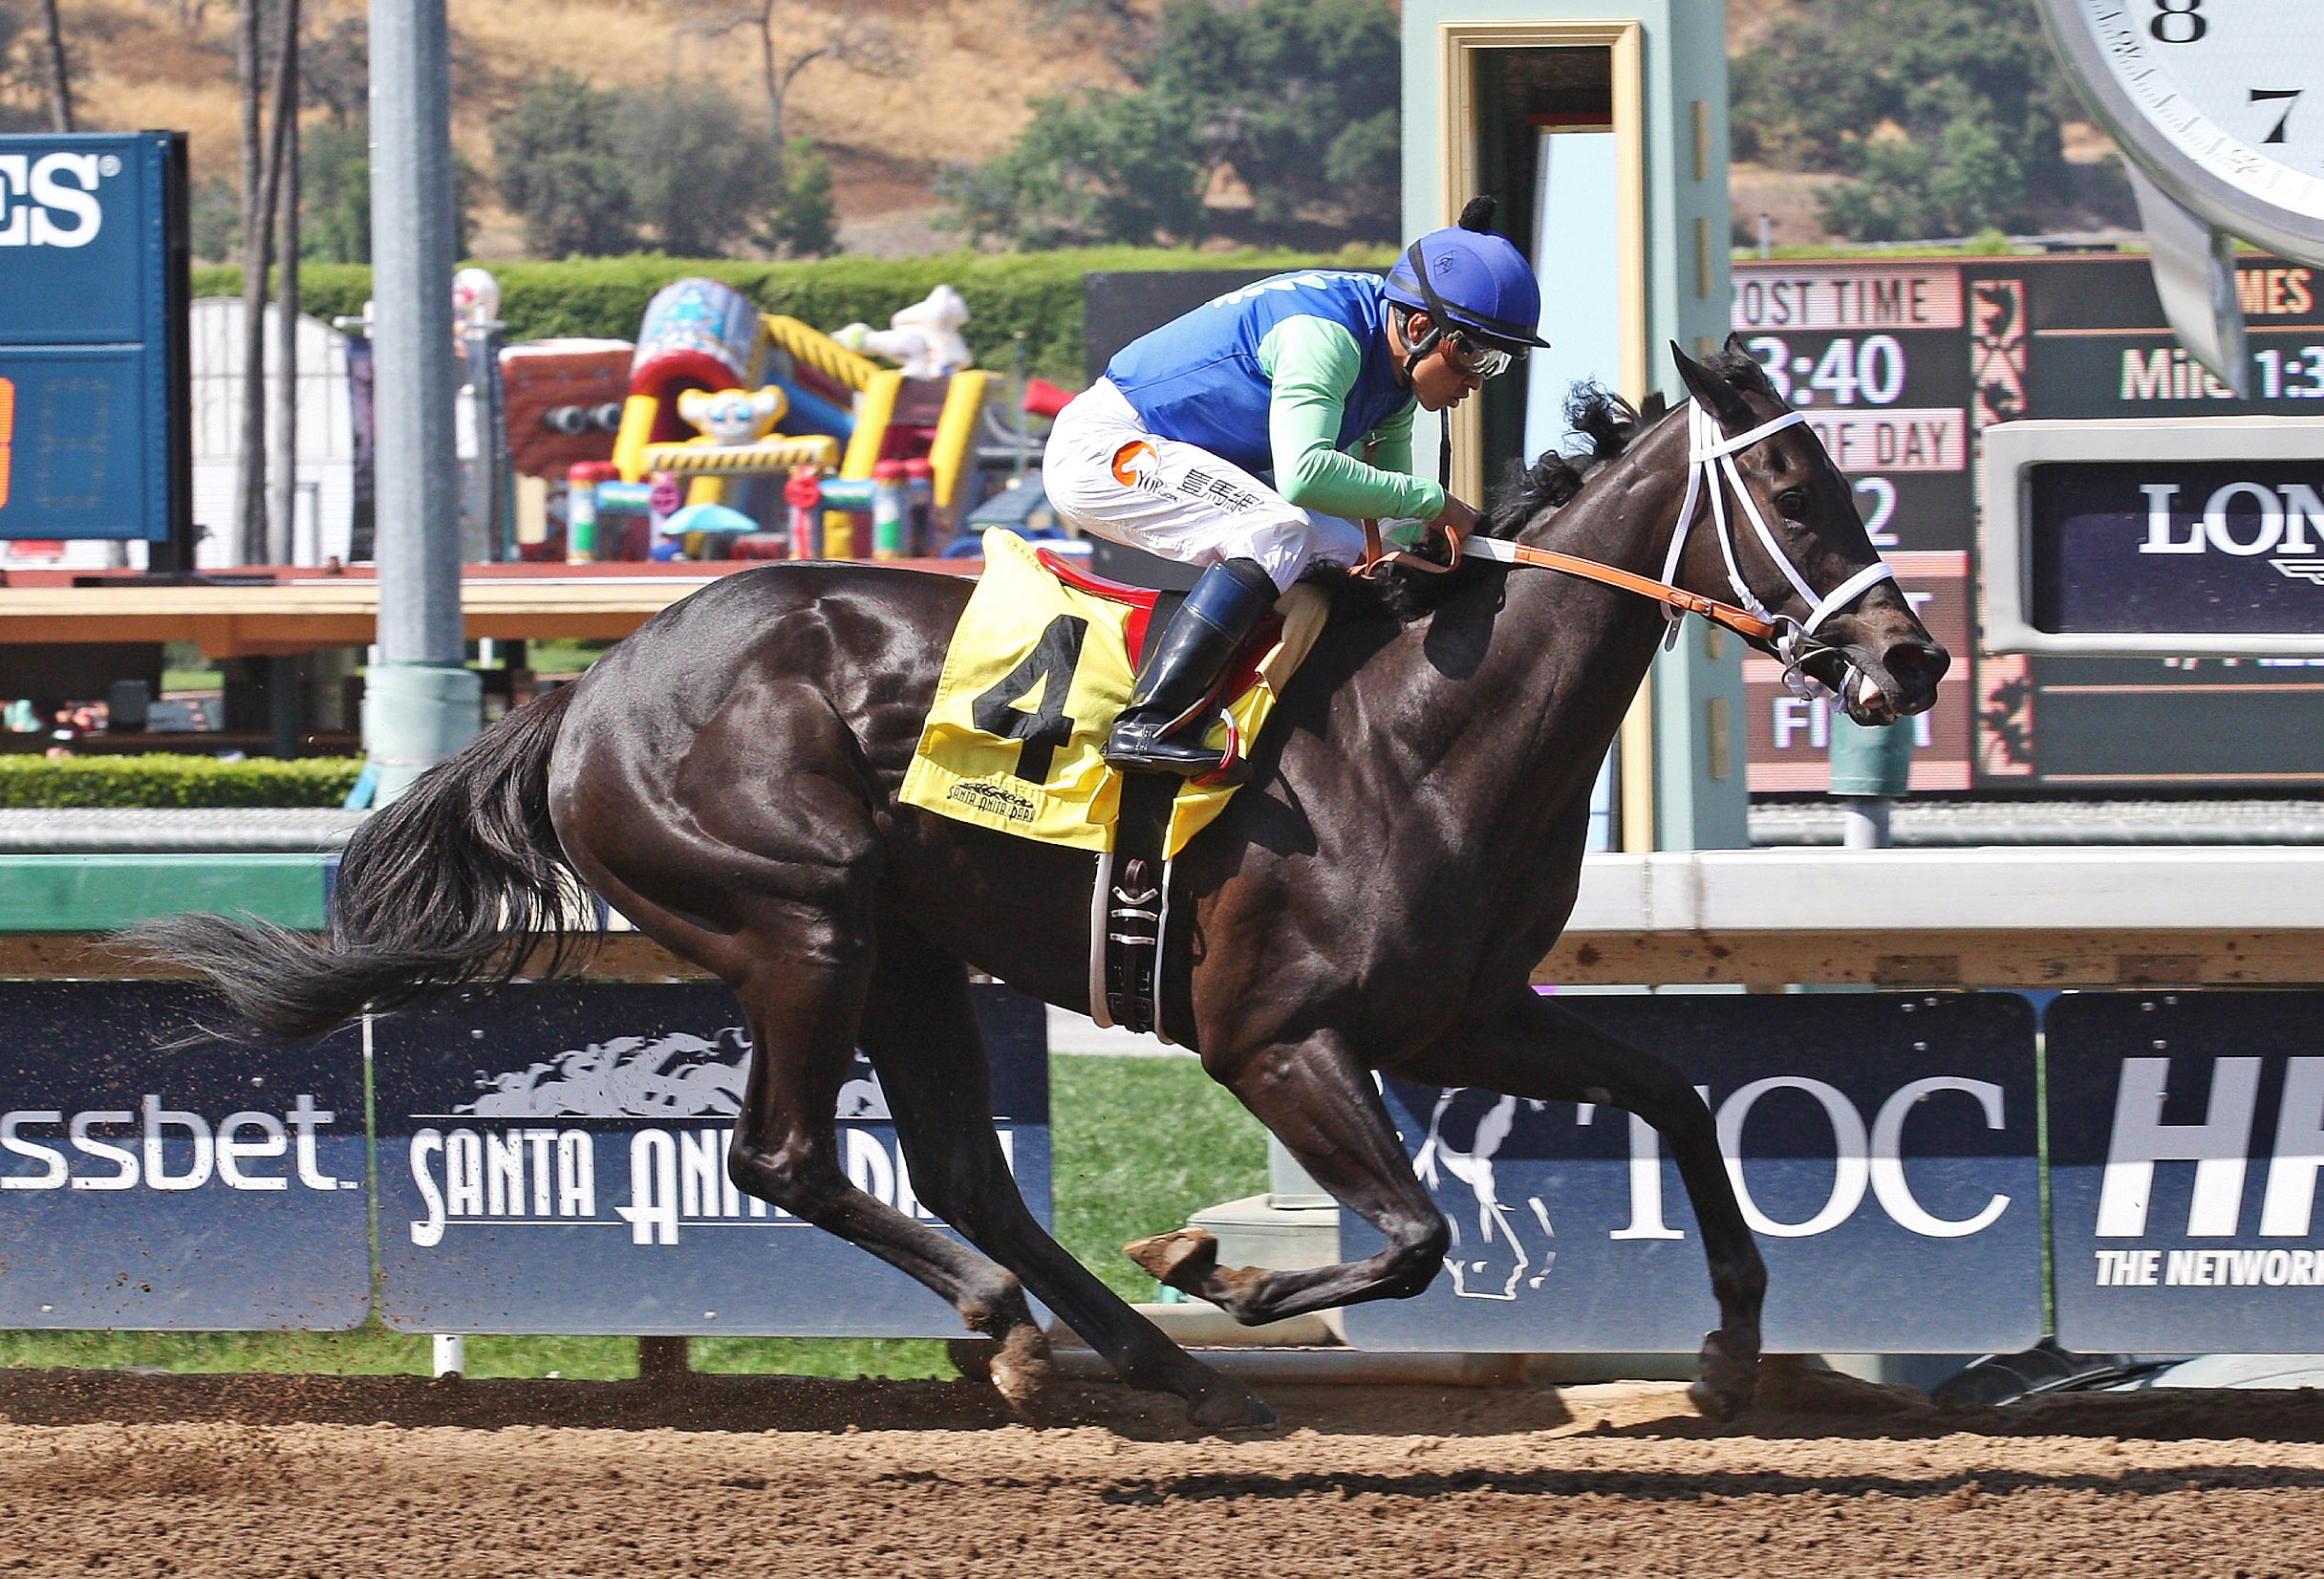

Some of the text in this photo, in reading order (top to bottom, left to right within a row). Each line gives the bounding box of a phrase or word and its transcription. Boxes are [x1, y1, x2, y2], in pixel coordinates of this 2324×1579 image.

[2150, 0, 2206, 44] 8
[2249, 88, 2305, 144] 7
[1732, 278, 1928, 324] OST TIME
[1748, 335, 1906, 405] 3:40
[1875, 422, 1947, 465] DAY
[2139, 481, 2324, 556] LON
[972, 614, 1088, 786] 4
[0, 1093, 338, 1191] ssbet
[1576, 1075, 2012, 1242] TOC
[409, 1127, 596, 1247] SANTA
[613, 1127, 793, 1246] ANI
[2095, 1249, 2163, 1287] THE
